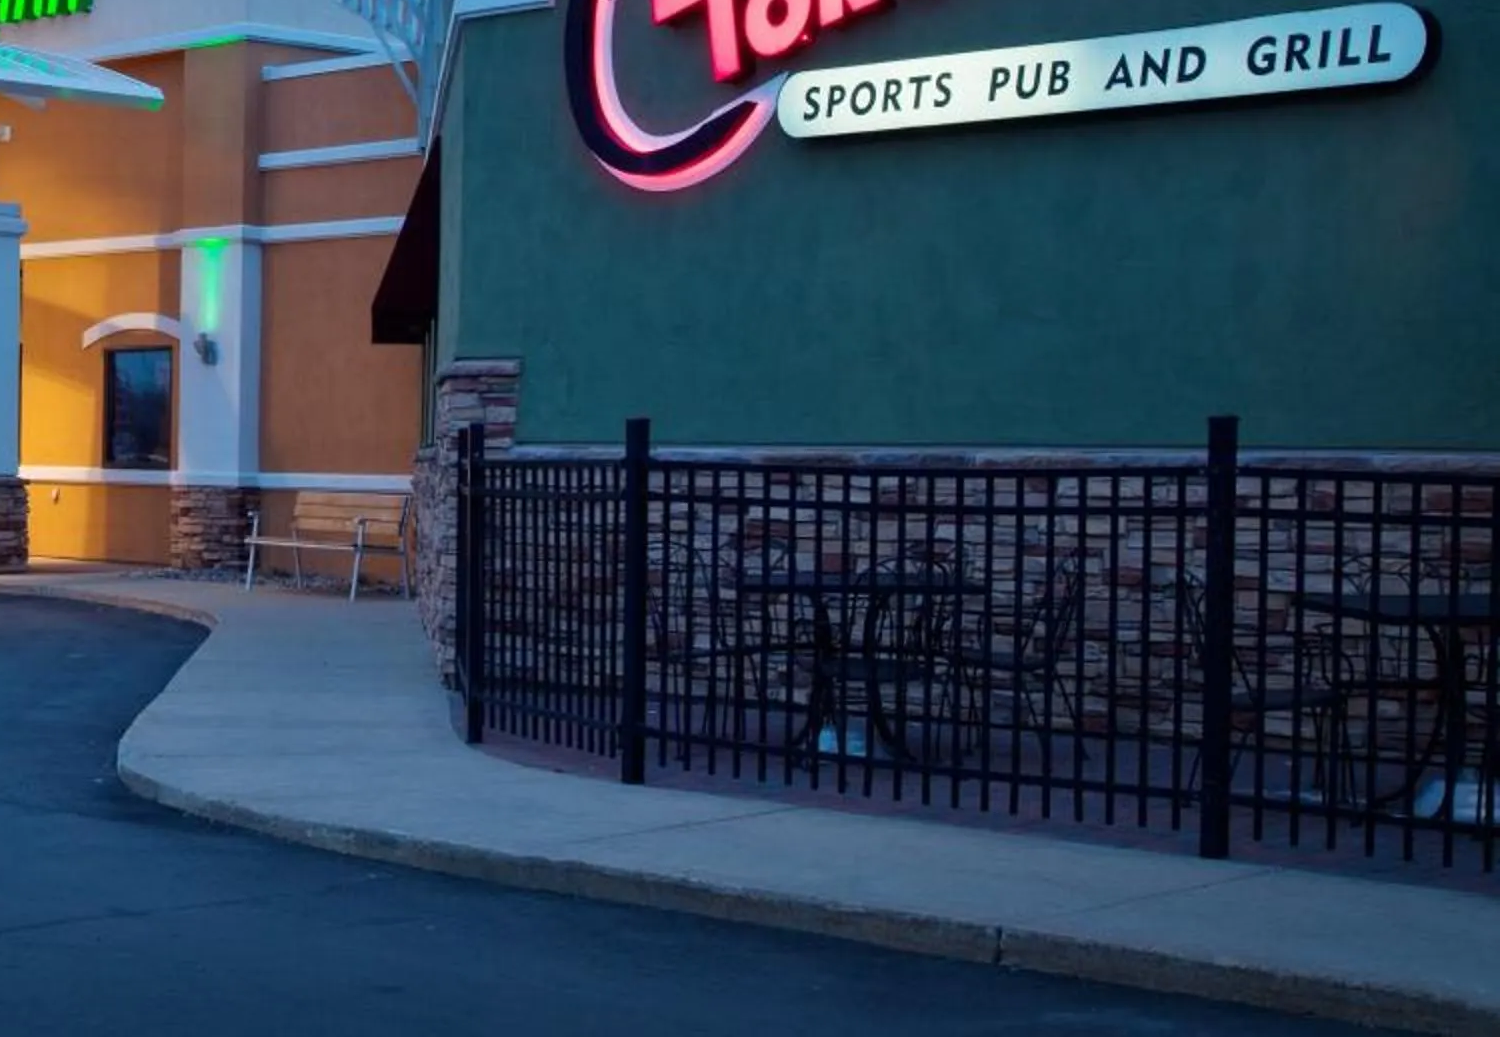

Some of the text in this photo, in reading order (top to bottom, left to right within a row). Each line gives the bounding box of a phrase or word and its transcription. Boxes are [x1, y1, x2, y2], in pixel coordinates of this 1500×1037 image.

[802, 23, 1393, 122] SPORTS PUB AND GRILL
